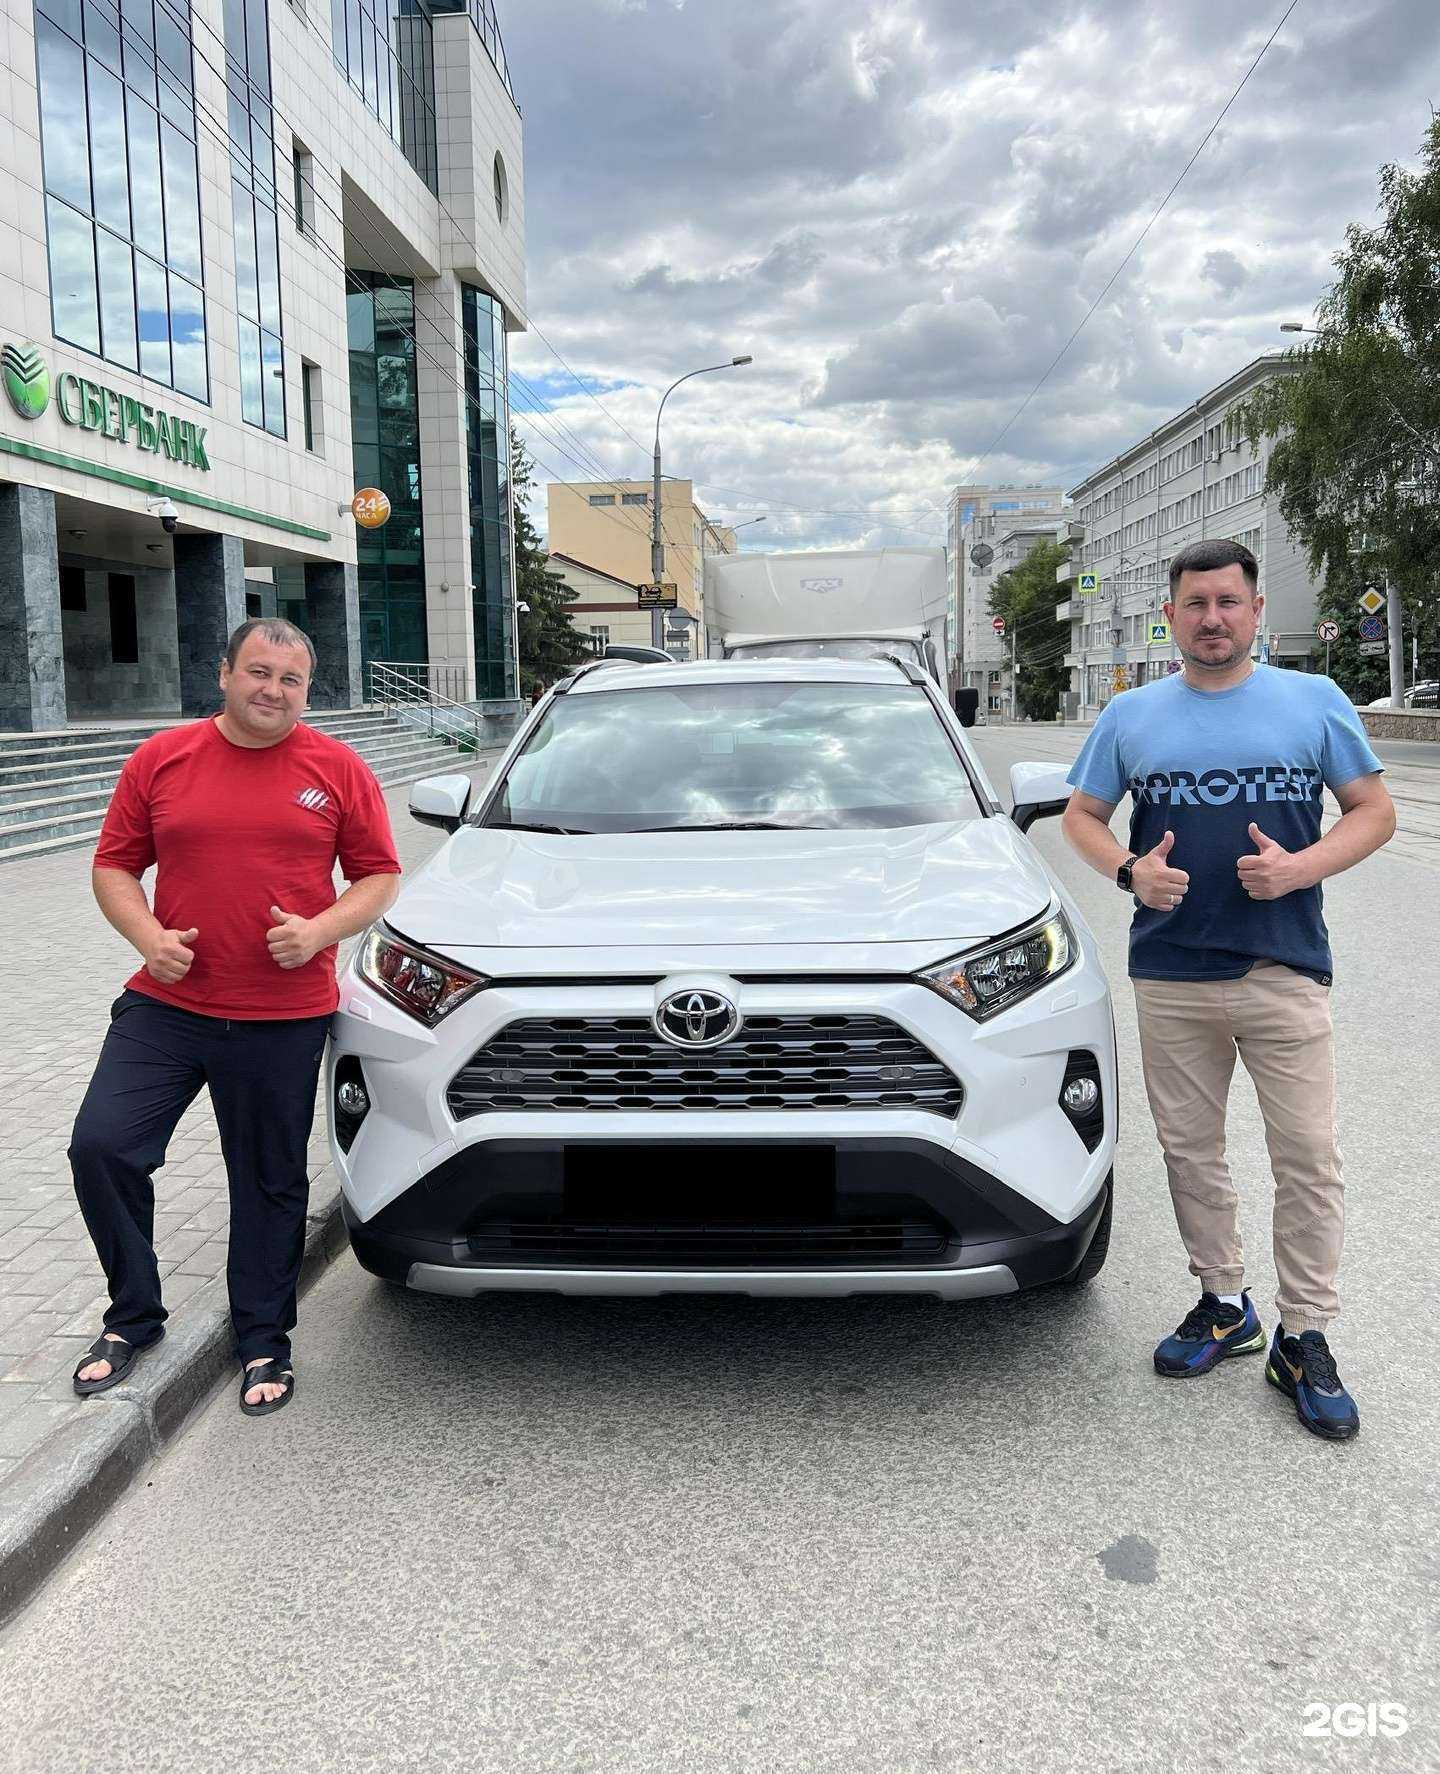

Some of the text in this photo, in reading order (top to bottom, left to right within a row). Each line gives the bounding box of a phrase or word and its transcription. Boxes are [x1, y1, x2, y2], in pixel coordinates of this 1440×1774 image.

[56, 372, 211, 472] СБЕРБАНК
[354, 497, 376, 512] 24
[1146, 767, 1318, 806] PROTEST
